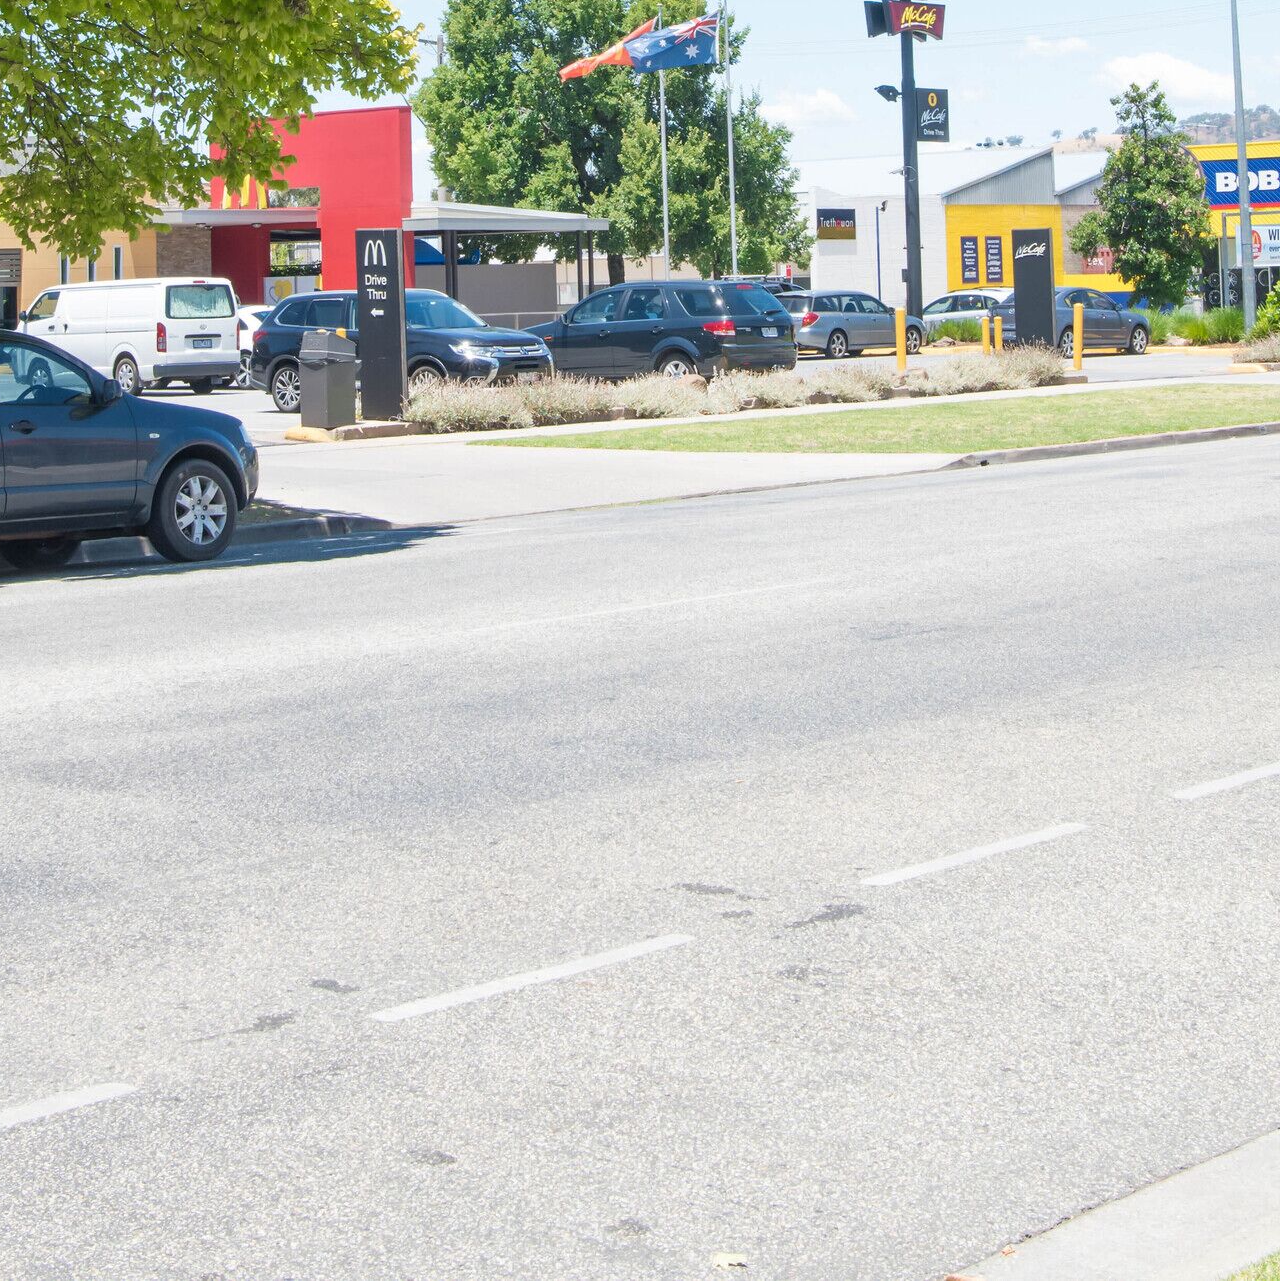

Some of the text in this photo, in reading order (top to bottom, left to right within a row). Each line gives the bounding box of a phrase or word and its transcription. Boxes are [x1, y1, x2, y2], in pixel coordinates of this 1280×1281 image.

[1215, 170, 1280, 192] BOB
[365, 274, 387, 285] Drive
[367, 288, 387, 299] Thru
